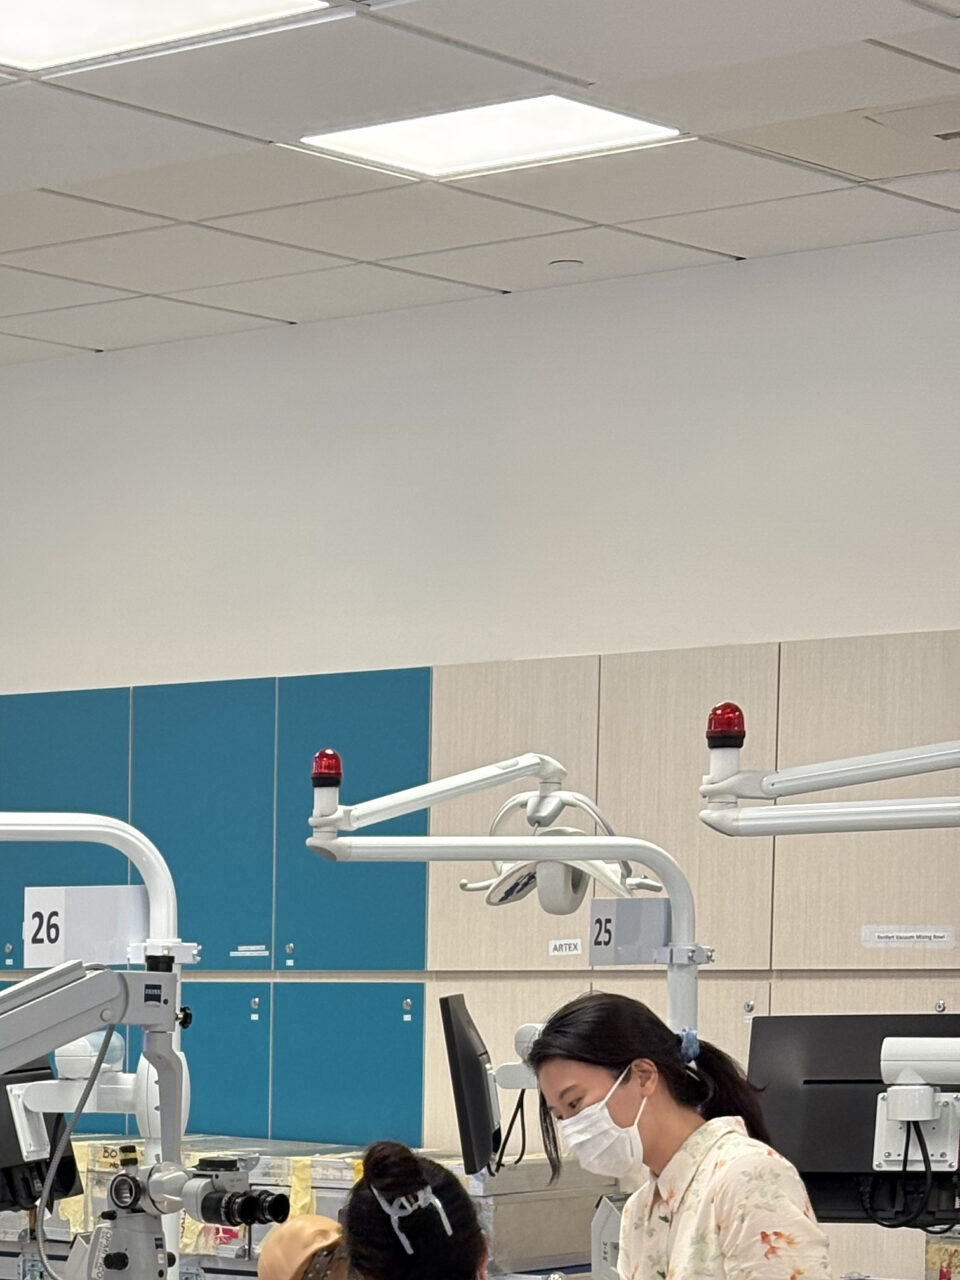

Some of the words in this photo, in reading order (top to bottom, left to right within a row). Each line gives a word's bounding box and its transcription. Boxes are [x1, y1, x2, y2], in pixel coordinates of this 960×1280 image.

[30, 911, 60, 945] 26
[593, 917, 612, 946] 25
[552, 942, 578, 953] ARTEX
